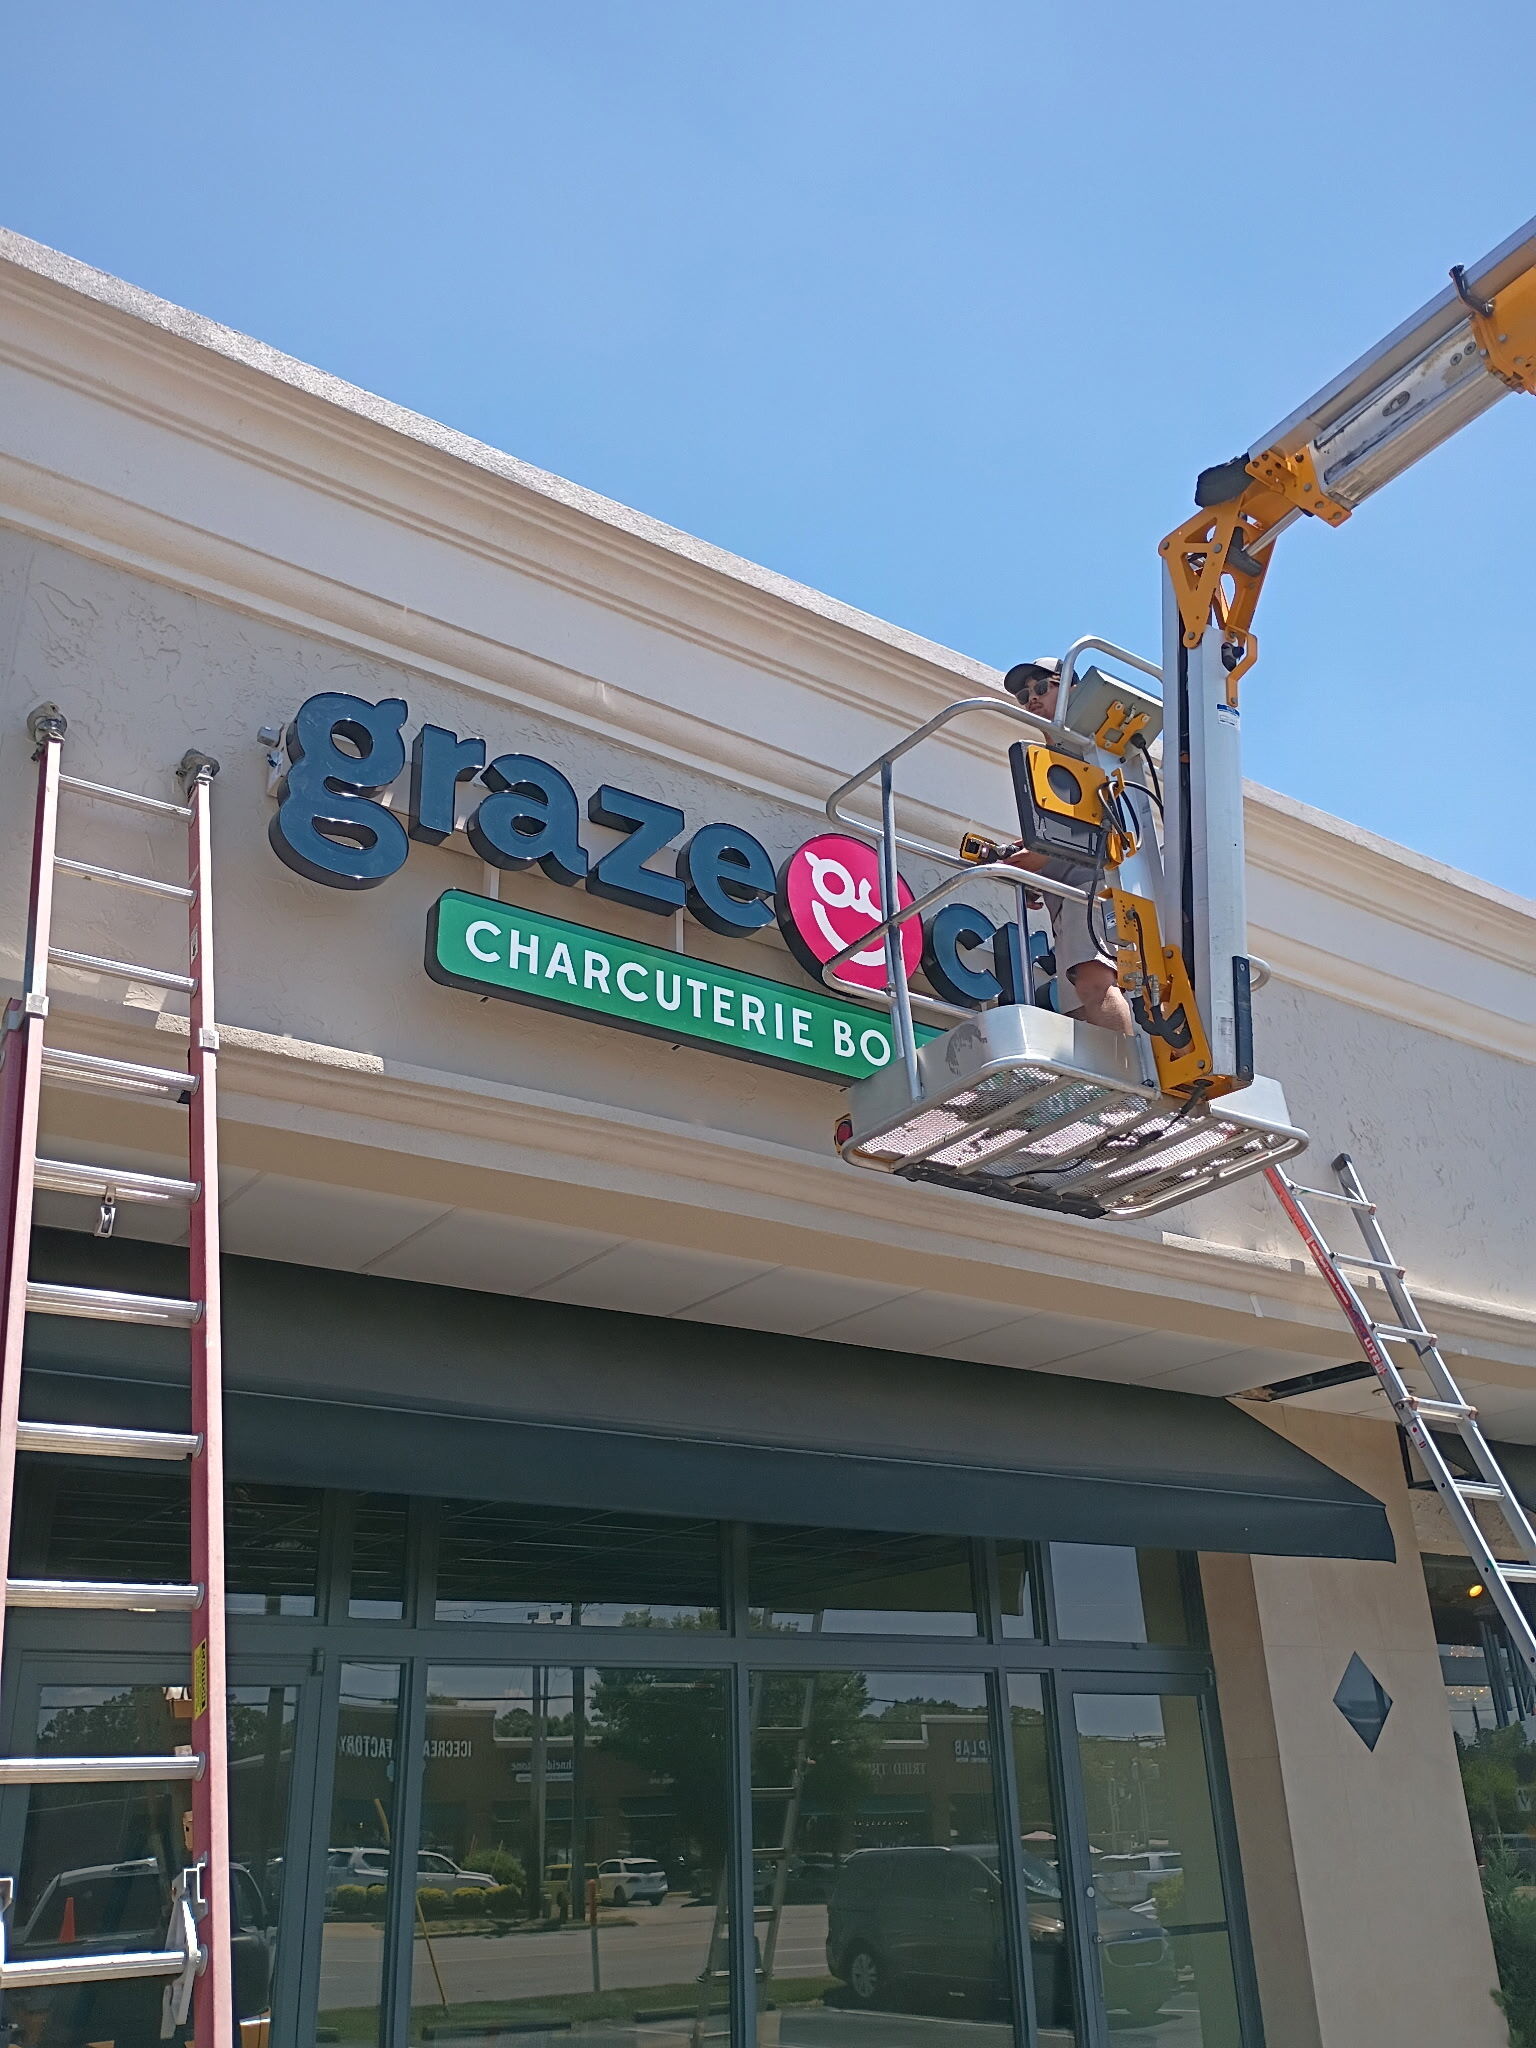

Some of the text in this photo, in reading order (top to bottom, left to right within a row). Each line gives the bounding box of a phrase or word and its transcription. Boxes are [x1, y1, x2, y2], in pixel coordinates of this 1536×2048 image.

[269, 691, 777, 938] graze
[465, 920, 814, 1048] CHARCUTERIE
[1364, 1338, 1380, 1363] LITE
